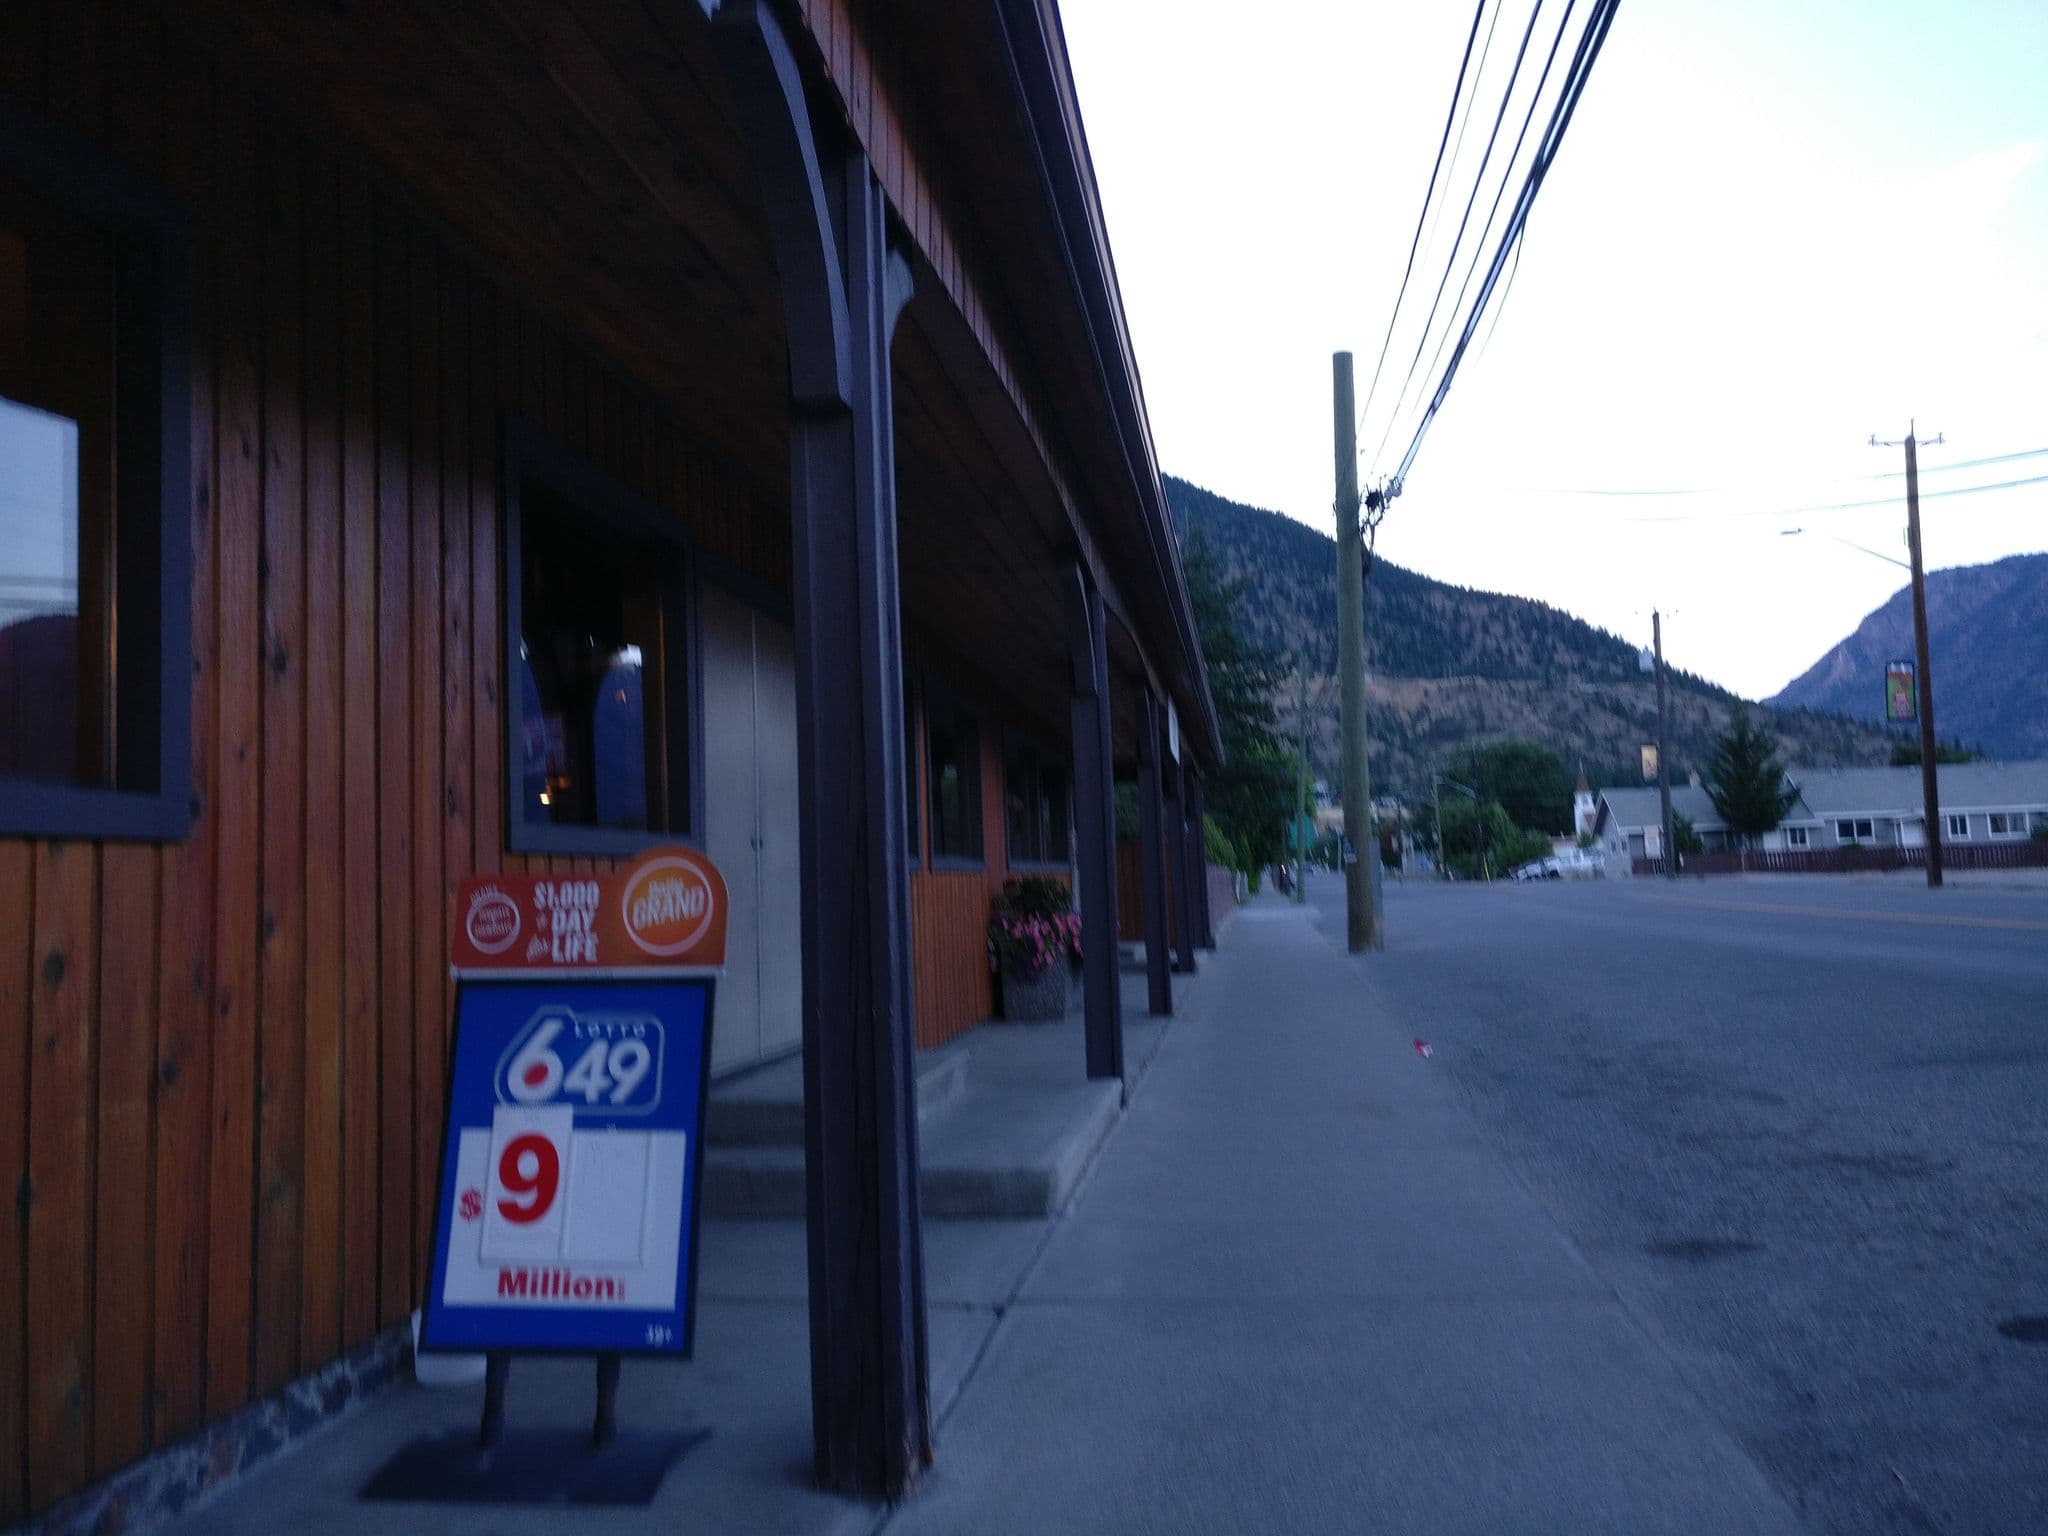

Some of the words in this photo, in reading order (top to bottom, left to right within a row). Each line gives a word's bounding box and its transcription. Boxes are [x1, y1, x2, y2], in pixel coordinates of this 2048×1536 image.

[633, 887, 704, 929] GRAND
[497, 1132, 559, 1226] 9
[498, 1267, 616, 1299] Million
